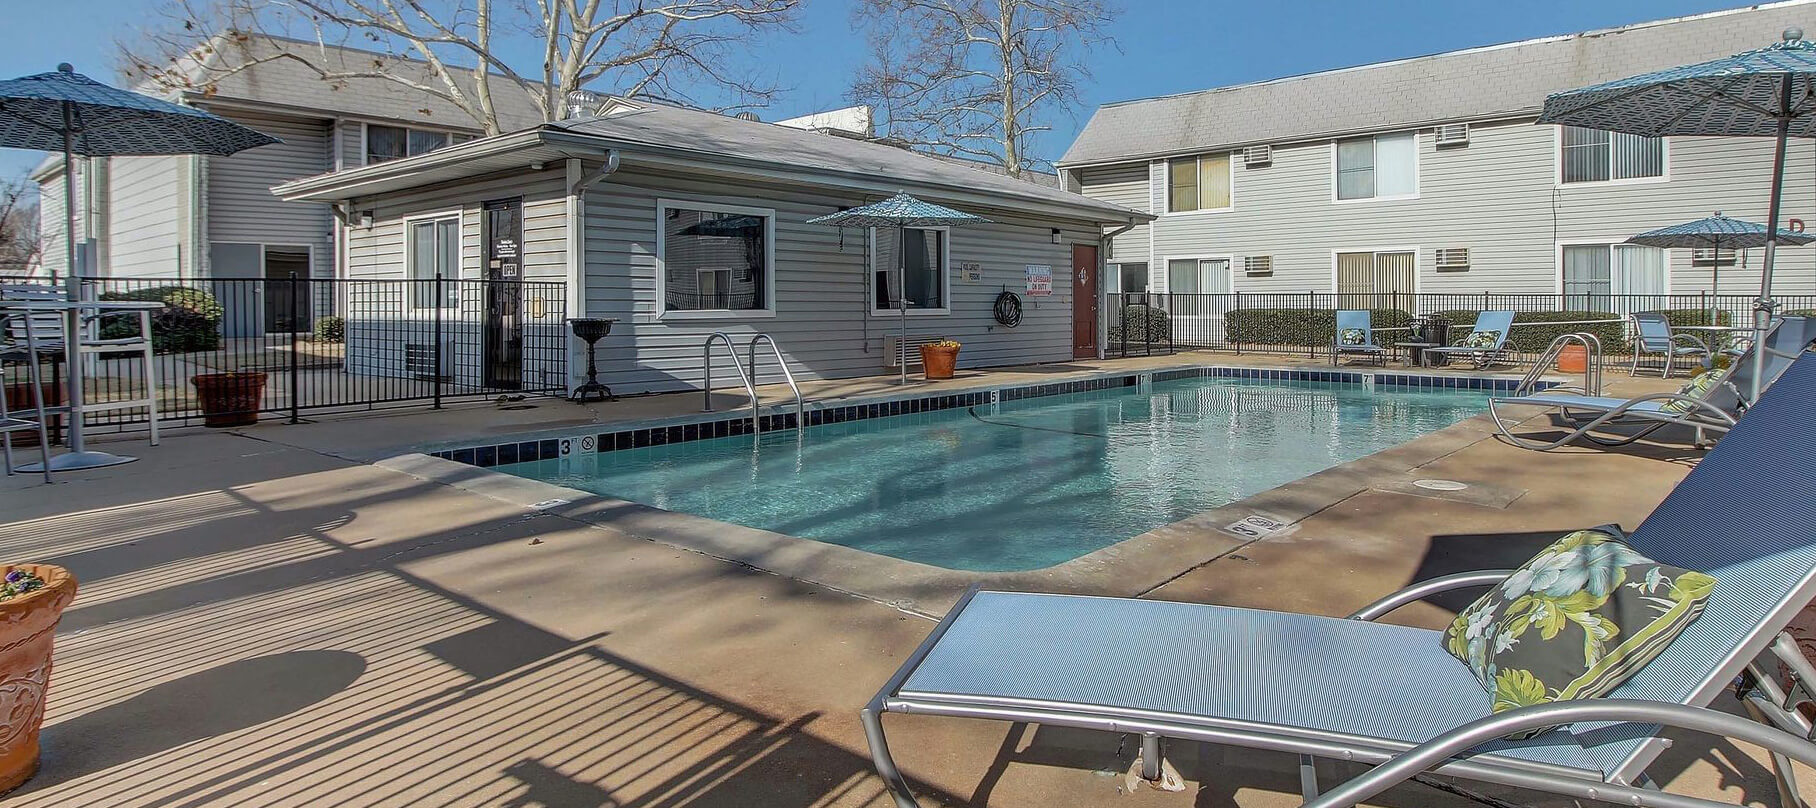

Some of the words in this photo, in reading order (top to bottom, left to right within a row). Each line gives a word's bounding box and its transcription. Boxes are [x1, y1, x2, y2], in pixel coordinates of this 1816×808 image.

[1789, 218, 1805, 233] D
[504, 265, 516, 275] OPEN
[561, 439, 571, 455] 3
[1232, 526, 1258, 536] 3
